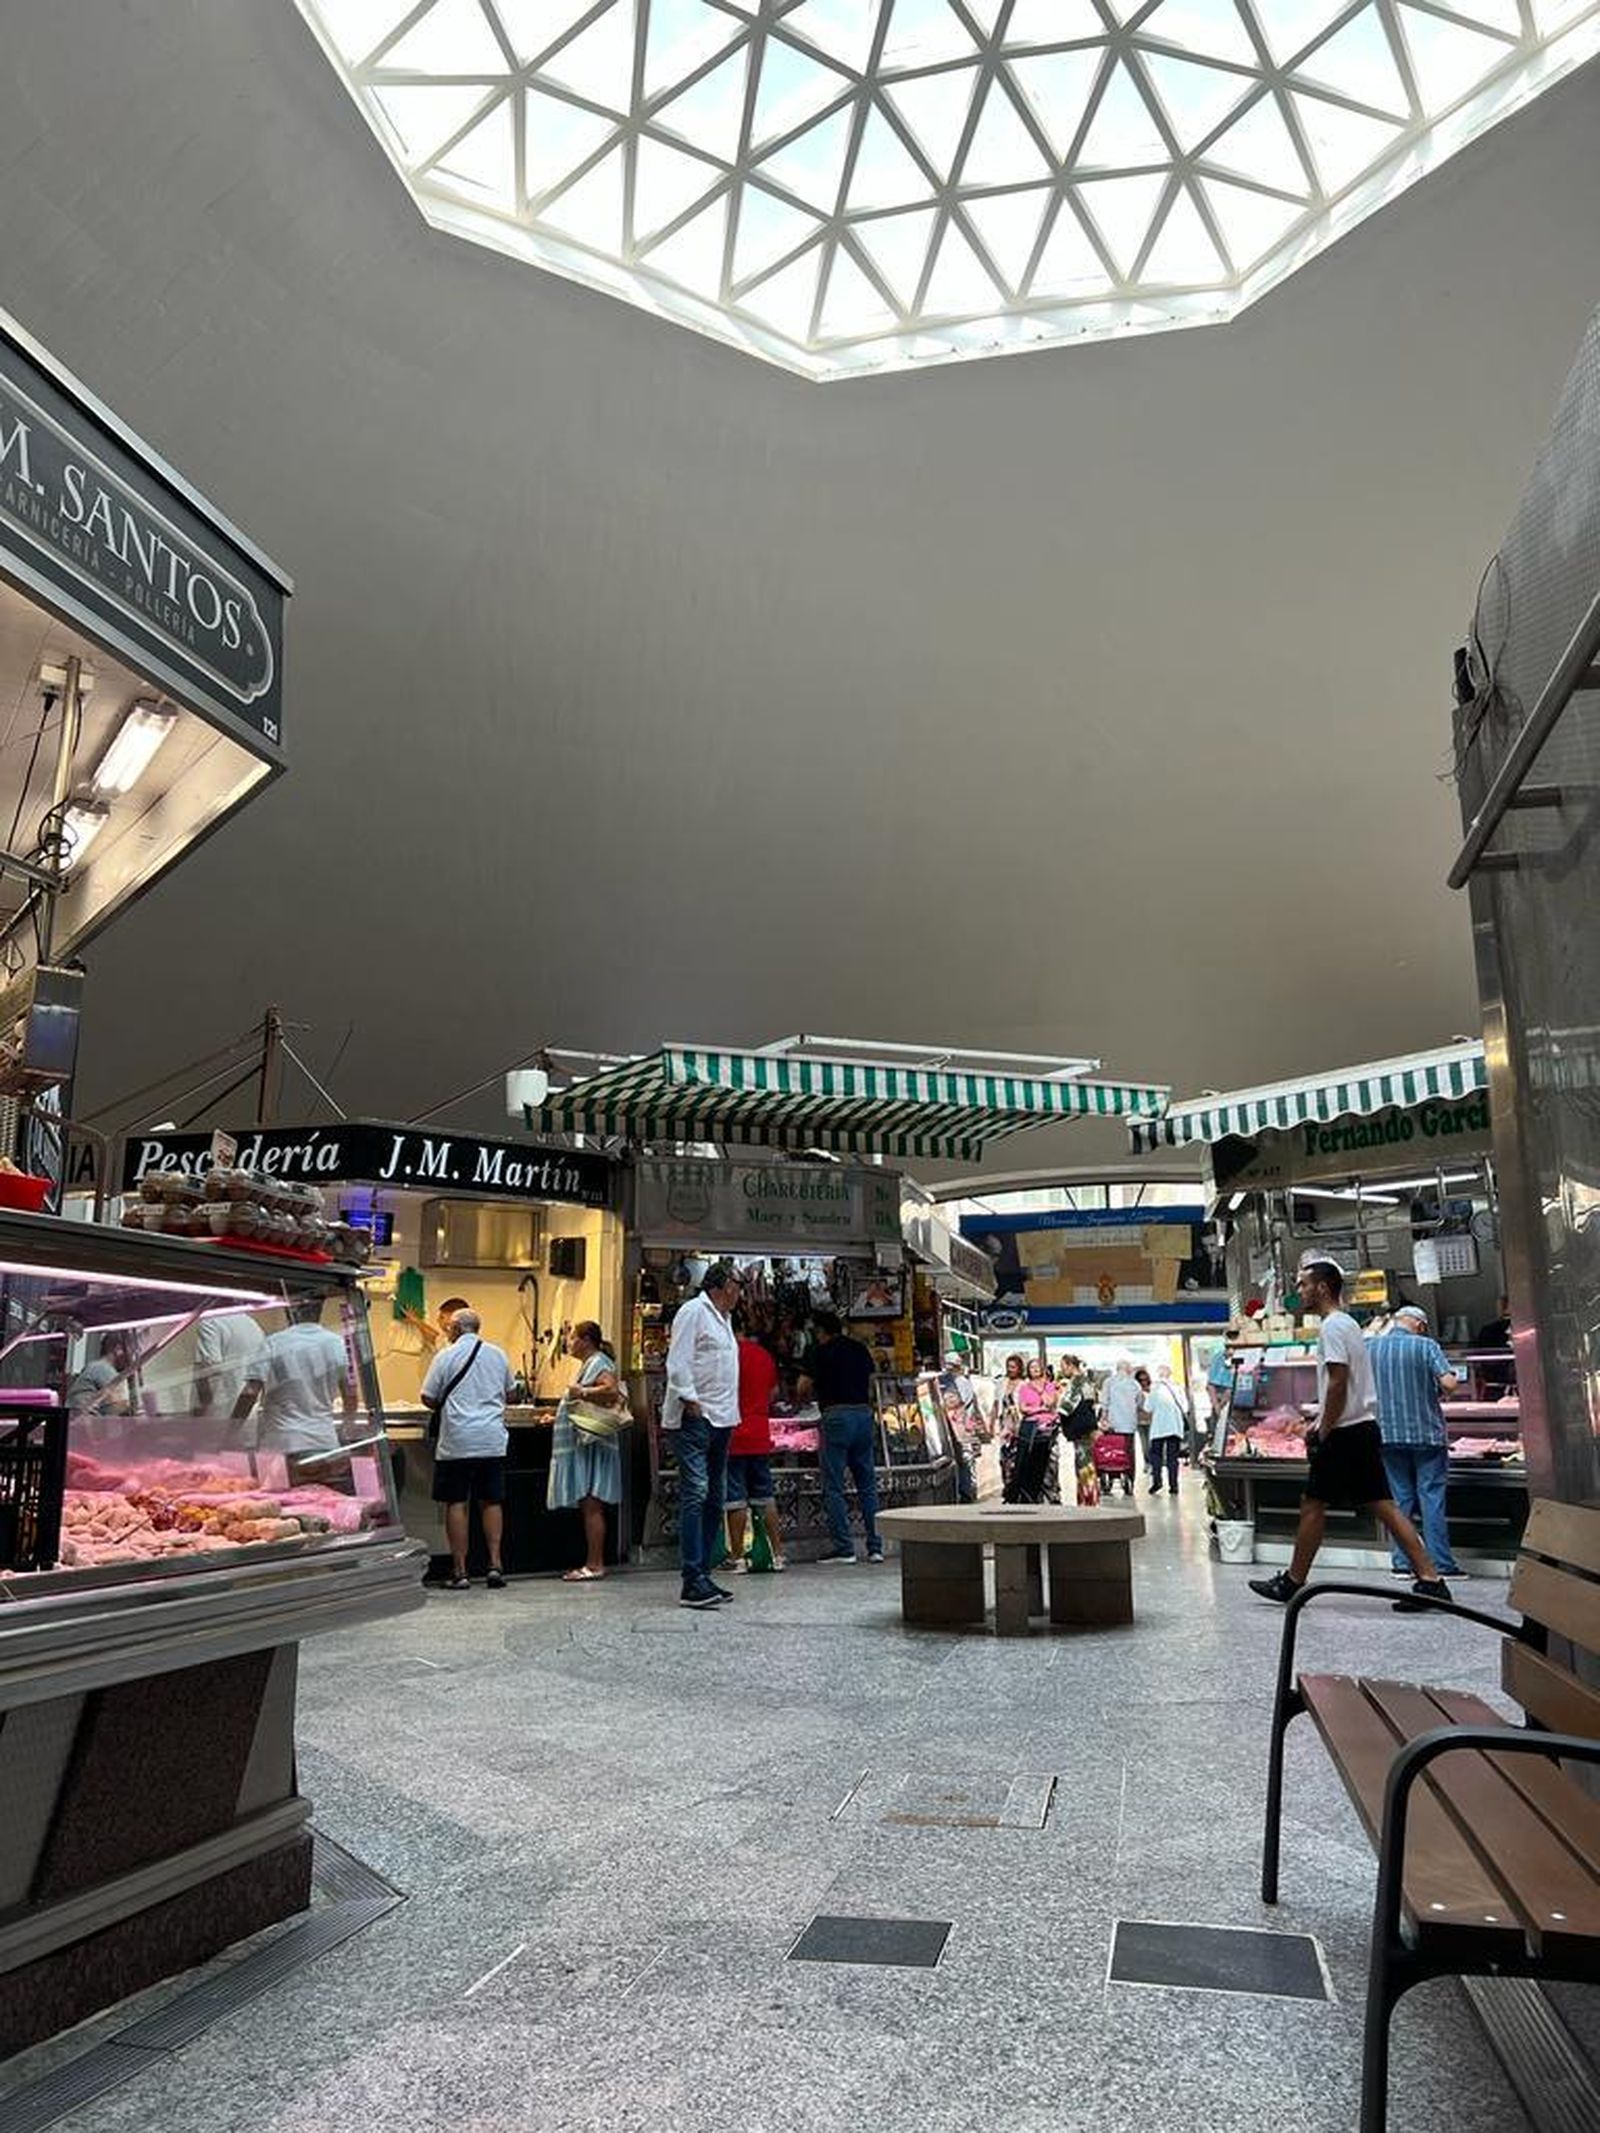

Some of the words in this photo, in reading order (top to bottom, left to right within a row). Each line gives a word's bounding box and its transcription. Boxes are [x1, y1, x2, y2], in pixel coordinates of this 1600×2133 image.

[59, 463, 243, 650] SANTOS
[132, 1131, 341, 1181] Pescdería
[379, 1134, 460, 1180] J.M.
[472, 1146, 581, 1193] Martín
[1304, 1110, 1414, 1156] Fernando
